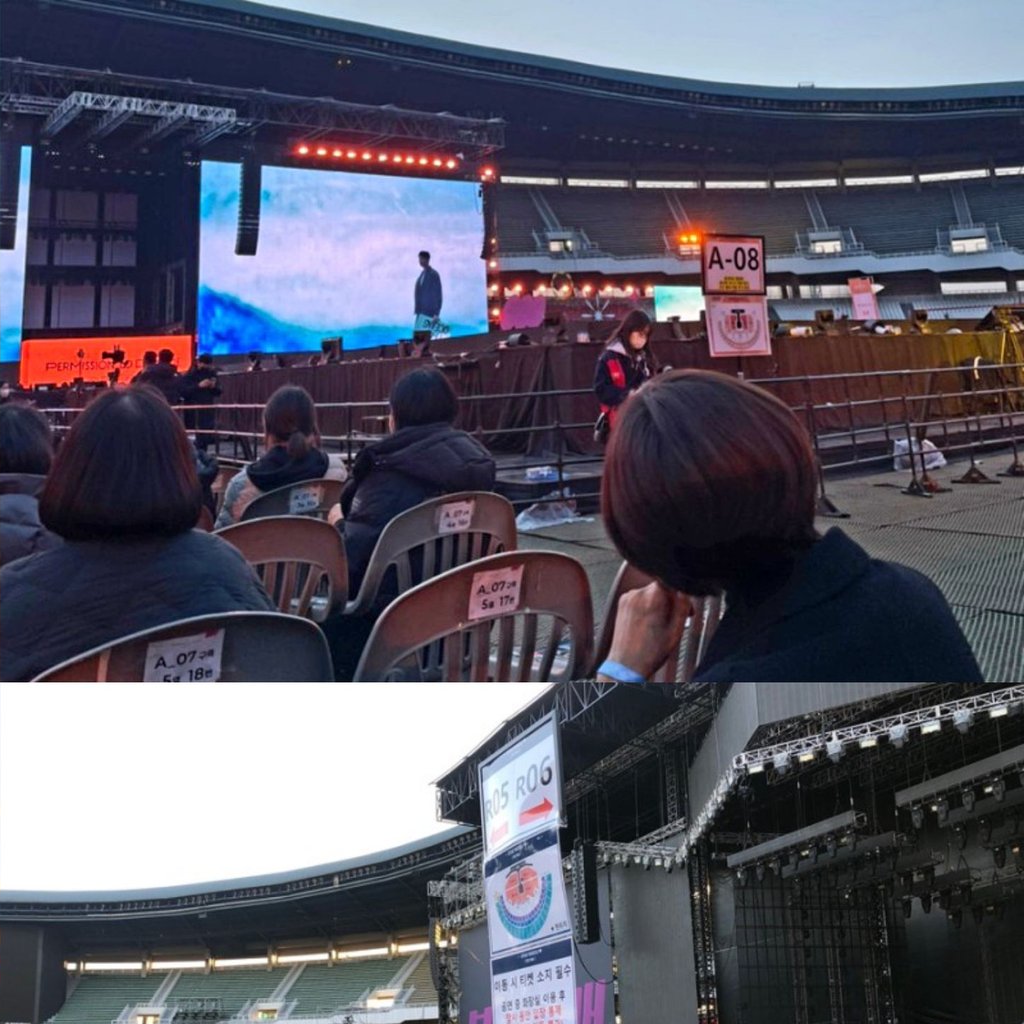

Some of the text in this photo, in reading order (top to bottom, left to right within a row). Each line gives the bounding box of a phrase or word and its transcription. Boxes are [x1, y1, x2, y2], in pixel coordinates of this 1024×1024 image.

[708, 246, 760, 271] A-08
[516, 755, 553, 800] R06
[511, 976, 518, 988] 시
[519, 972, 534, 986] 티켓
[537, 968, 553, 982] 소지
